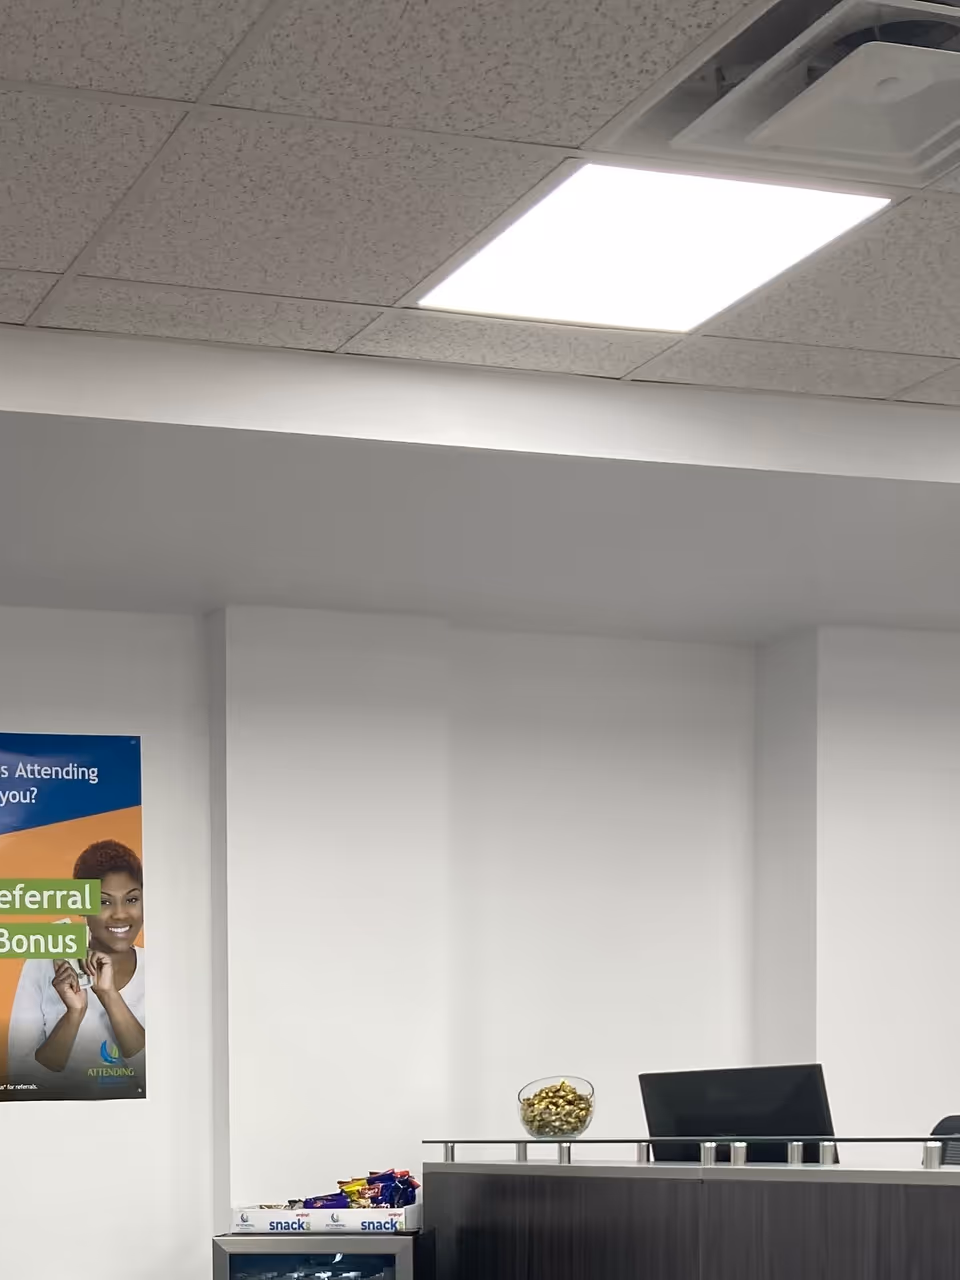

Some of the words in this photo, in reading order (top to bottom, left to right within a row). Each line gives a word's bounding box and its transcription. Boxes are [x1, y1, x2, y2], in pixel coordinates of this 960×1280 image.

[15, 762, 99, 784] Attending
[0, 787, 38, 807] you?
[87, 1067, 135, 1077] ATTENDING
[269, 1218, 305, 1231] snack
[361, 1218, 398, 1231] snack
